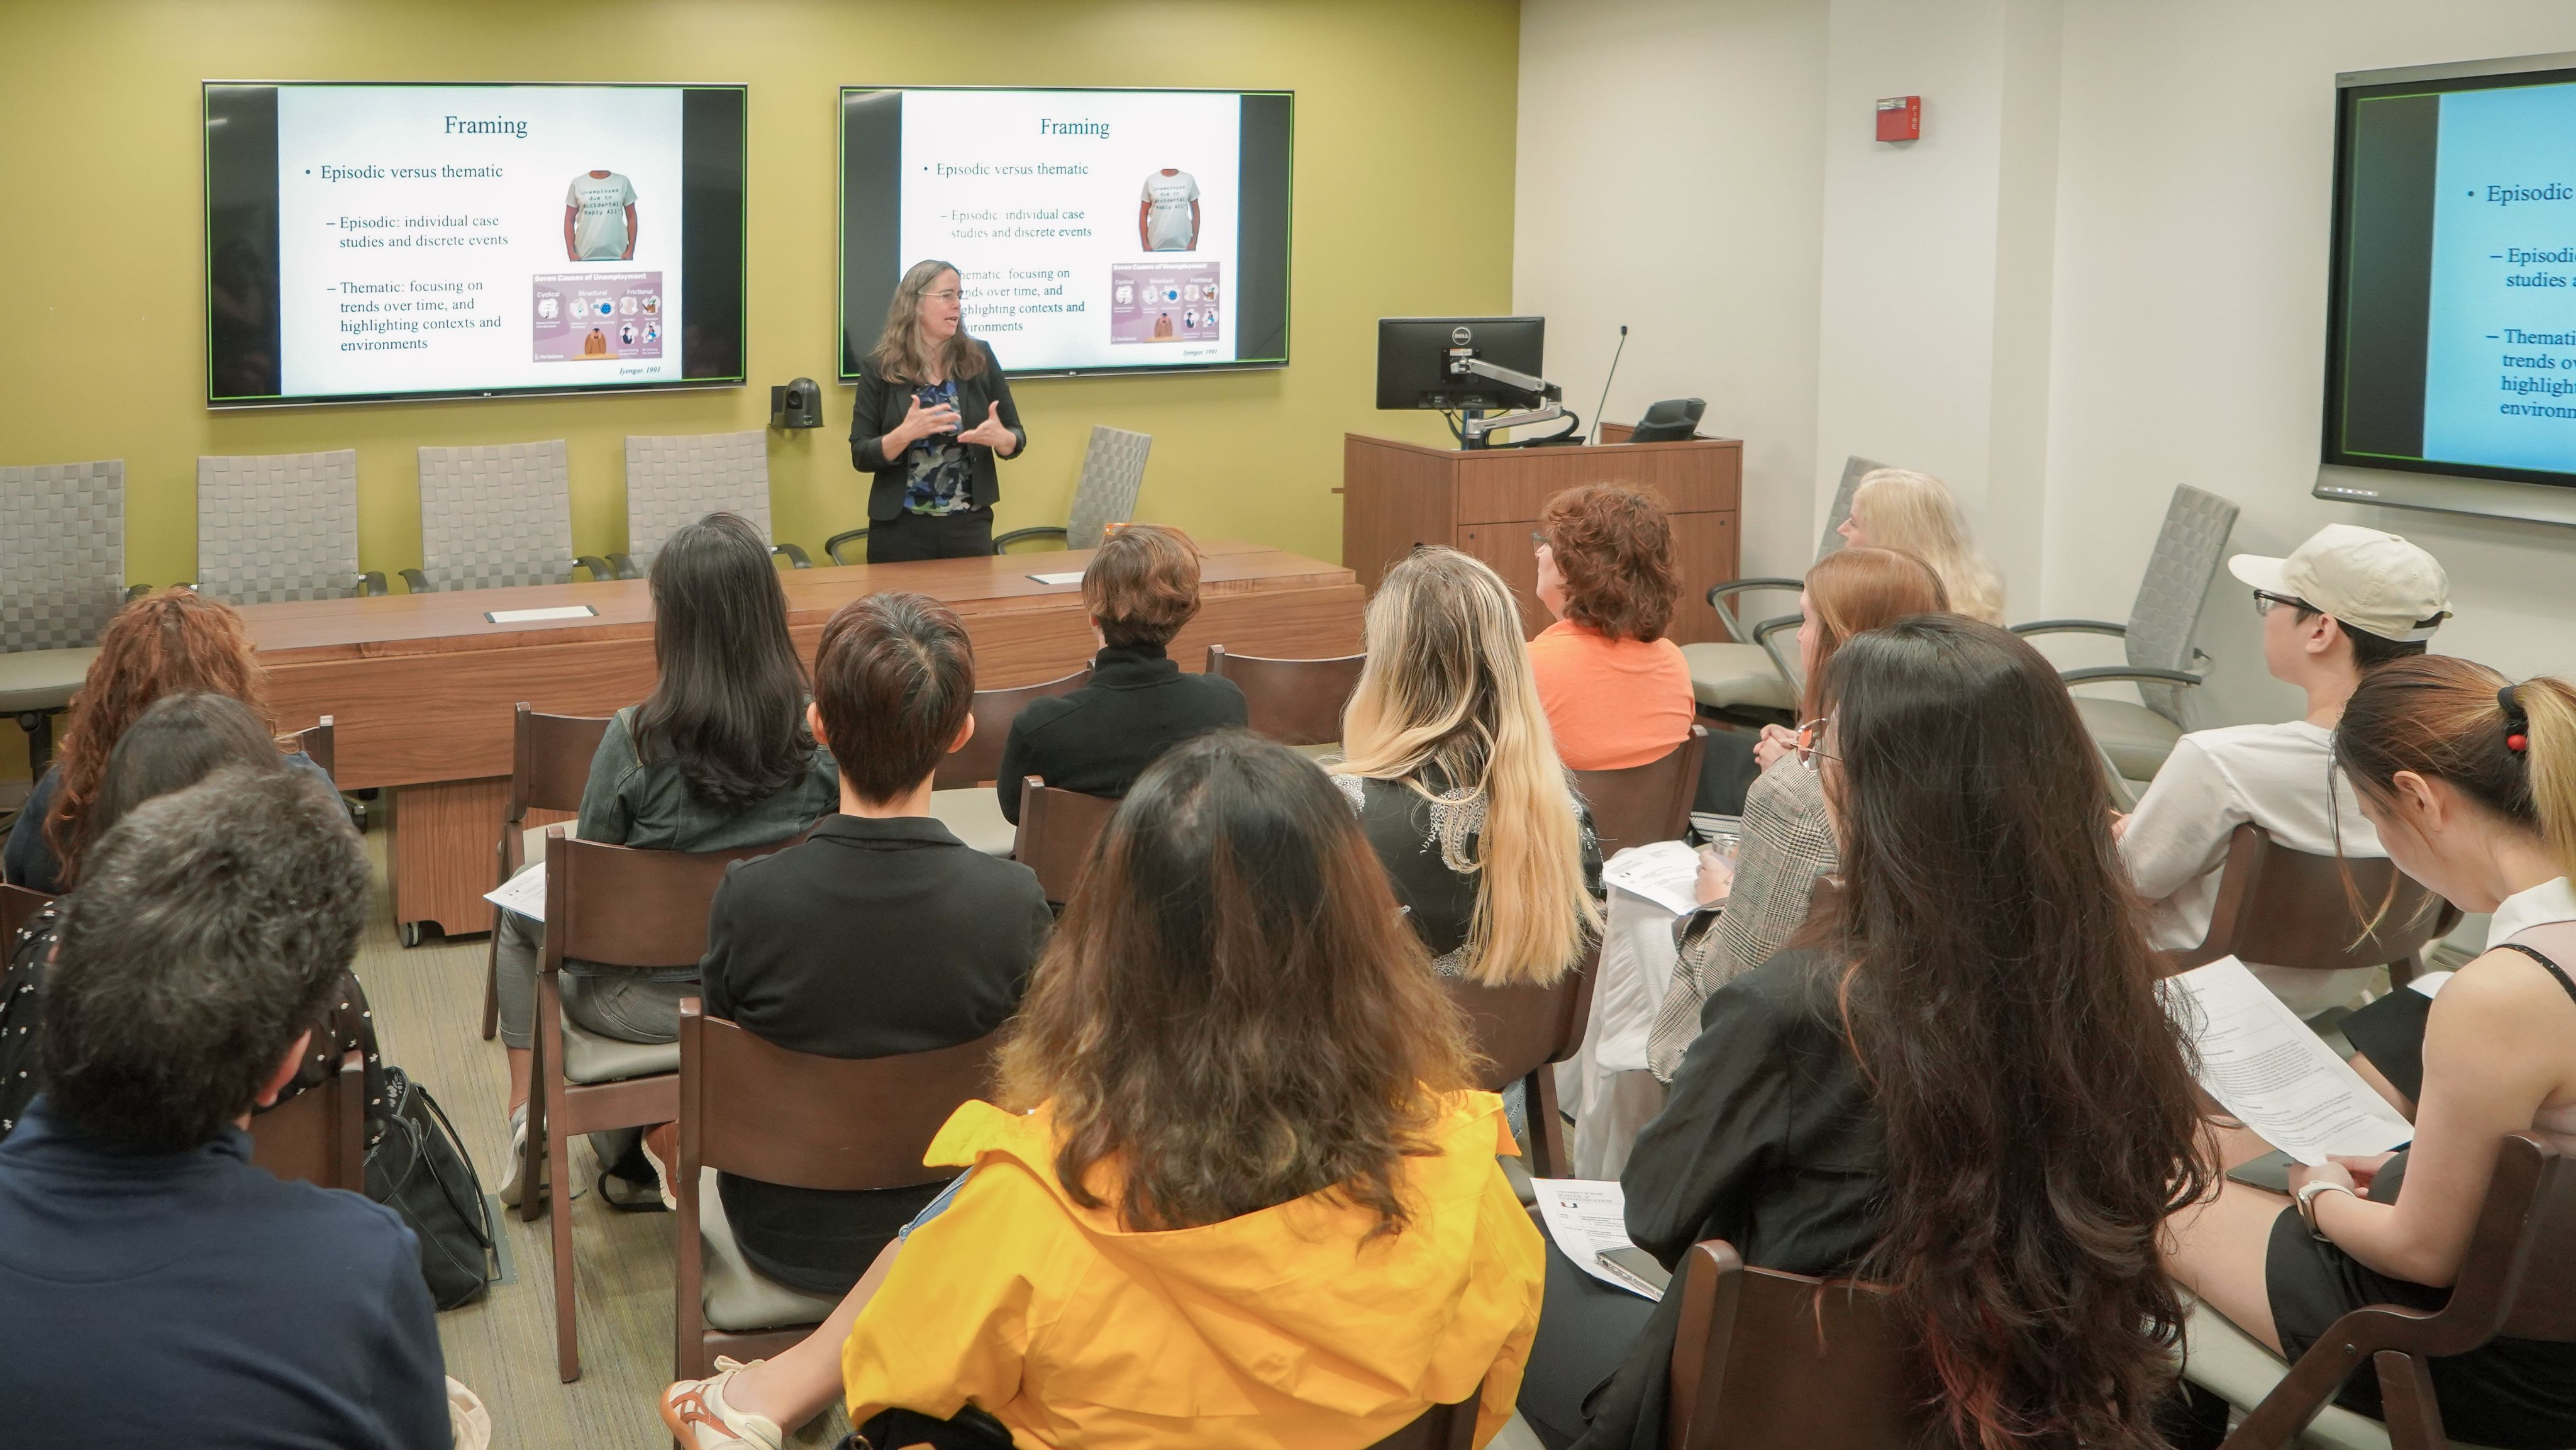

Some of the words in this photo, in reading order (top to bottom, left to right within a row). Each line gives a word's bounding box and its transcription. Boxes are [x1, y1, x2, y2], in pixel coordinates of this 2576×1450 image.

[445, 116, 528, 138] Framing
[1041, 118, 1109, 139] Framing
[321, 165, 384, 182] Episodic
[391, 169, 436, 177] versus
[442, 164, 502, 177] thematic
[938, 163, 989, 178] Episodic
[1038, 163, 1088, 174] thematic
[2486, 183, 2573, 206] Episodic
[1006, 209, 1058, 220] individual
[340, 216, 399, 231] Episodic:
[406, 215, 467, 227] individual
[952, 228, 987, 238] studies
[992, 227, 1010, 237] and
[1015, 227, 1055, 237] discrete
[1059, 228, 1091, 237] events
[340, 236, 384, 248] studies
[389, 235, 411, 247] and
[416, 235, 464, 246] discrete
[469, 236, 508, 245] events
[2507, 248, 2576, 267] Episodi
[594, 273, 647, 281] Unemployment
[1009, 269, 1053, 281] focusing
[2506, 272, 2567, 287] studies
[340, 281, 404, 293] Thematic:
[410, 280, 463, 294] focusing
[1044, 284, 1062, 295] and
[341, 301, 379, 313] trends
[384, 303, 412, 311] over
[417, 299, 447, 311] time,
[453, 298, 474, 310] and
[961, 303, 1017, 318] ghlighting
[1019, 304, 1063, 313] contexts
[1067, 301, 1085, 312] and
[341, 319, 418, 335] highlighting
[423, 319, 475, 329] contexts
[480, 316, 501, 327] and
[341, 339, 428, 351] environments
[2502, 354, 2555, 369] trends
[2501, 376, 2576, 397] highligh
